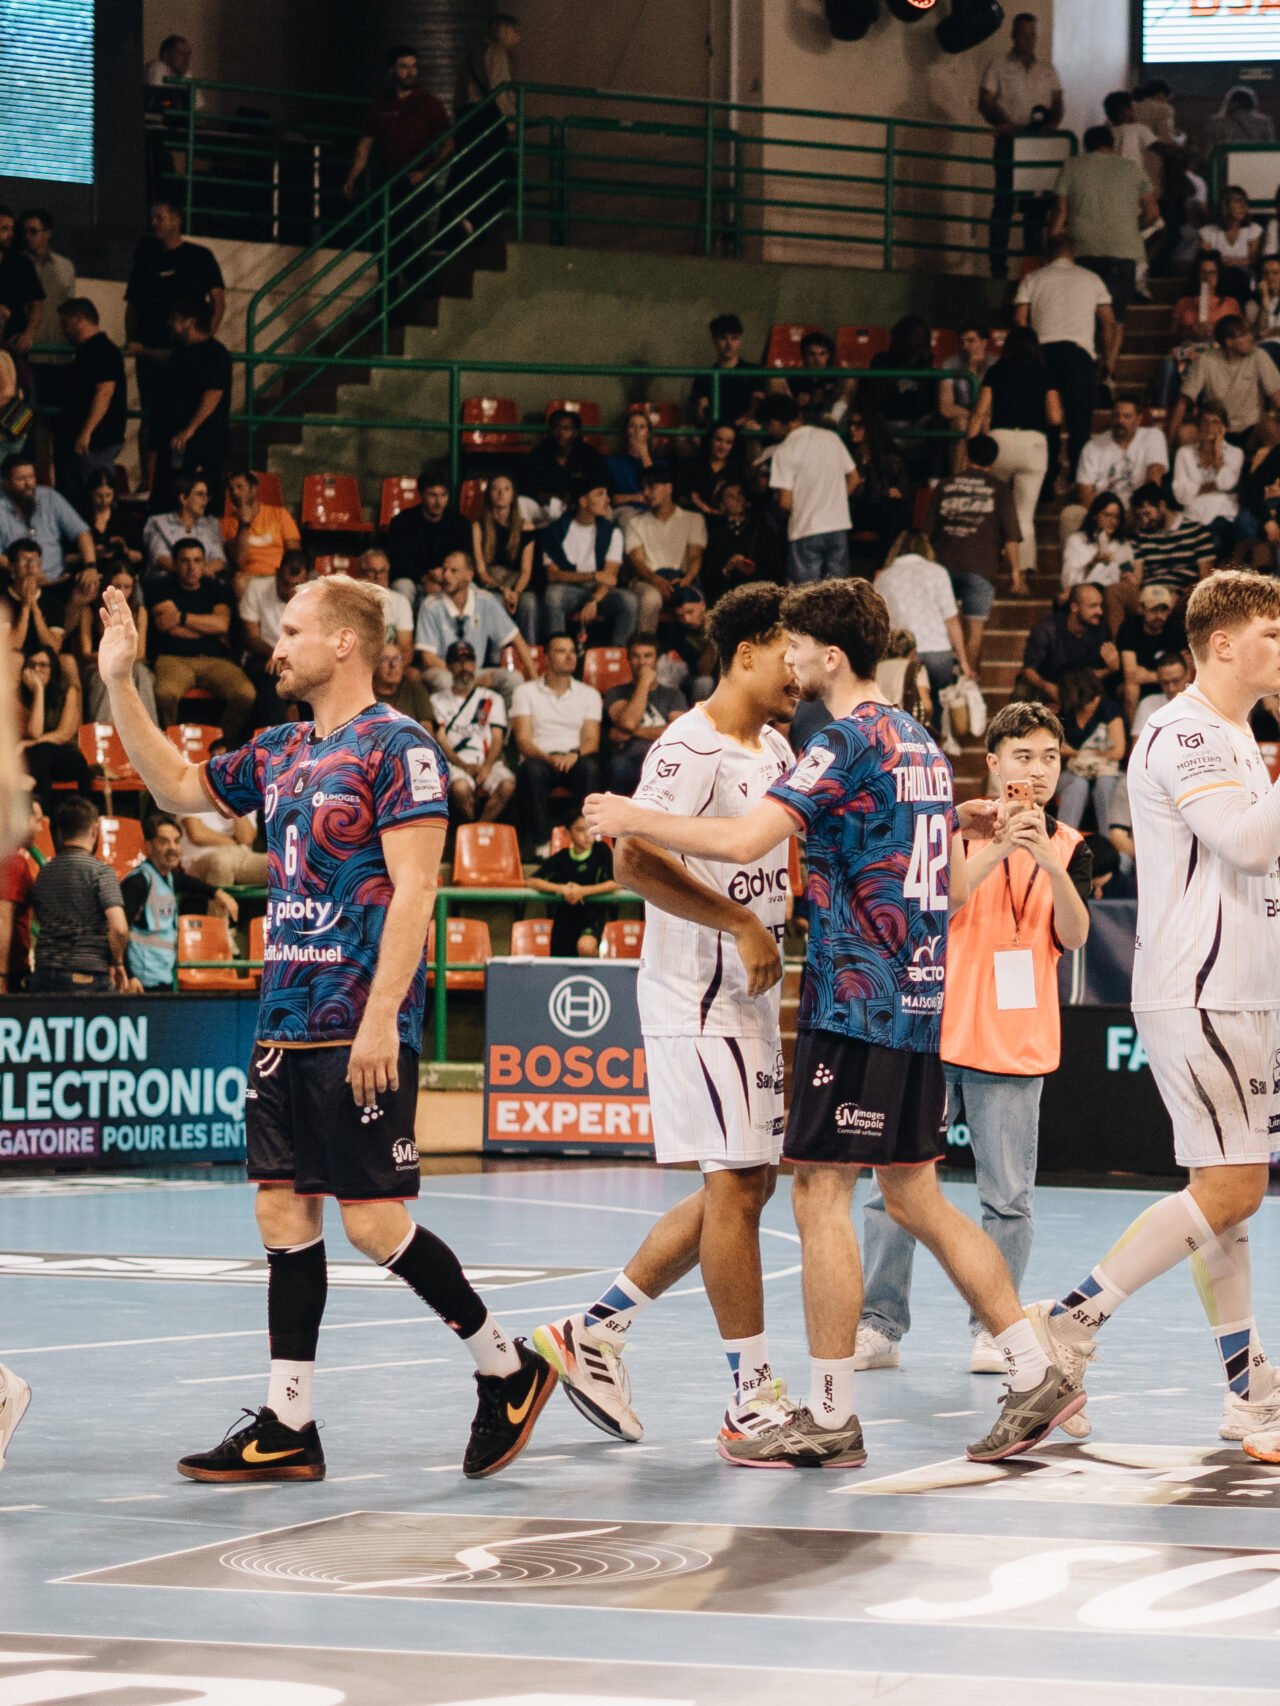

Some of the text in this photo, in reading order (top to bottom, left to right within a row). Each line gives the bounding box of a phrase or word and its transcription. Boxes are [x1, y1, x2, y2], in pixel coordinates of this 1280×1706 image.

[284, 824, 298, 876] 6
[903, 813, 949, 912] 42
[283, 944, 342, 962] Mutuel
[102, 1124, 165, 1152] POUR
[169, 1122, 208, 1150] LES
[824, 1374, 833, 1403] CRAFT
